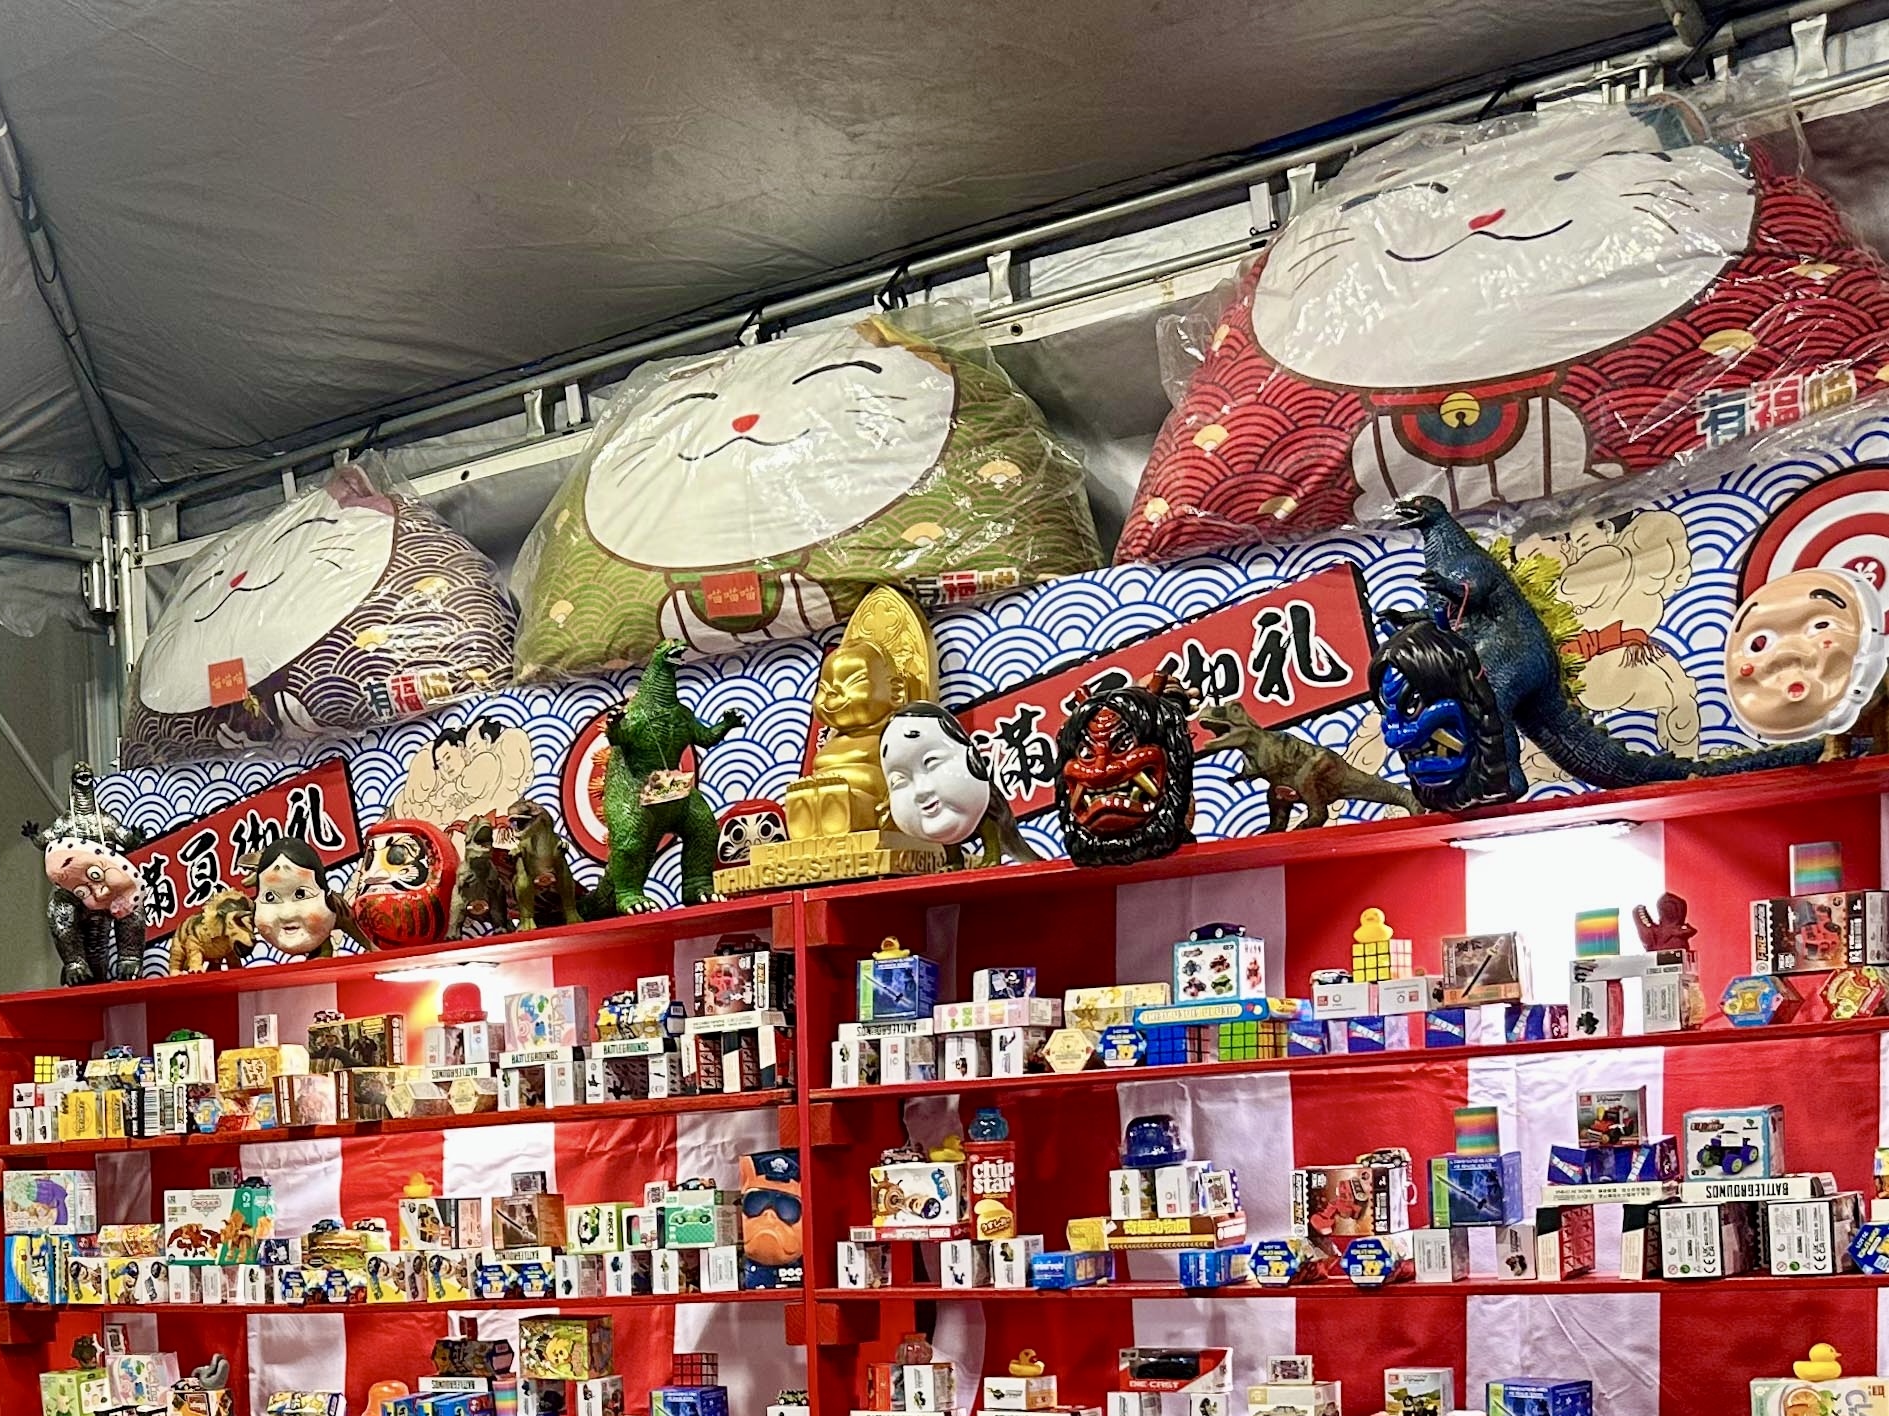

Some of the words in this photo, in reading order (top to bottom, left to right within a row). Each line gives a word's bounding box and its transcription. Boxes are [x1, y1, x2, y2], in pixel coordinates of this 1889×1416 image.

[973, 605, 1350, 798] 満御礼
[1706, 1183, 1789, 1198] BATTLEGROUNDS
